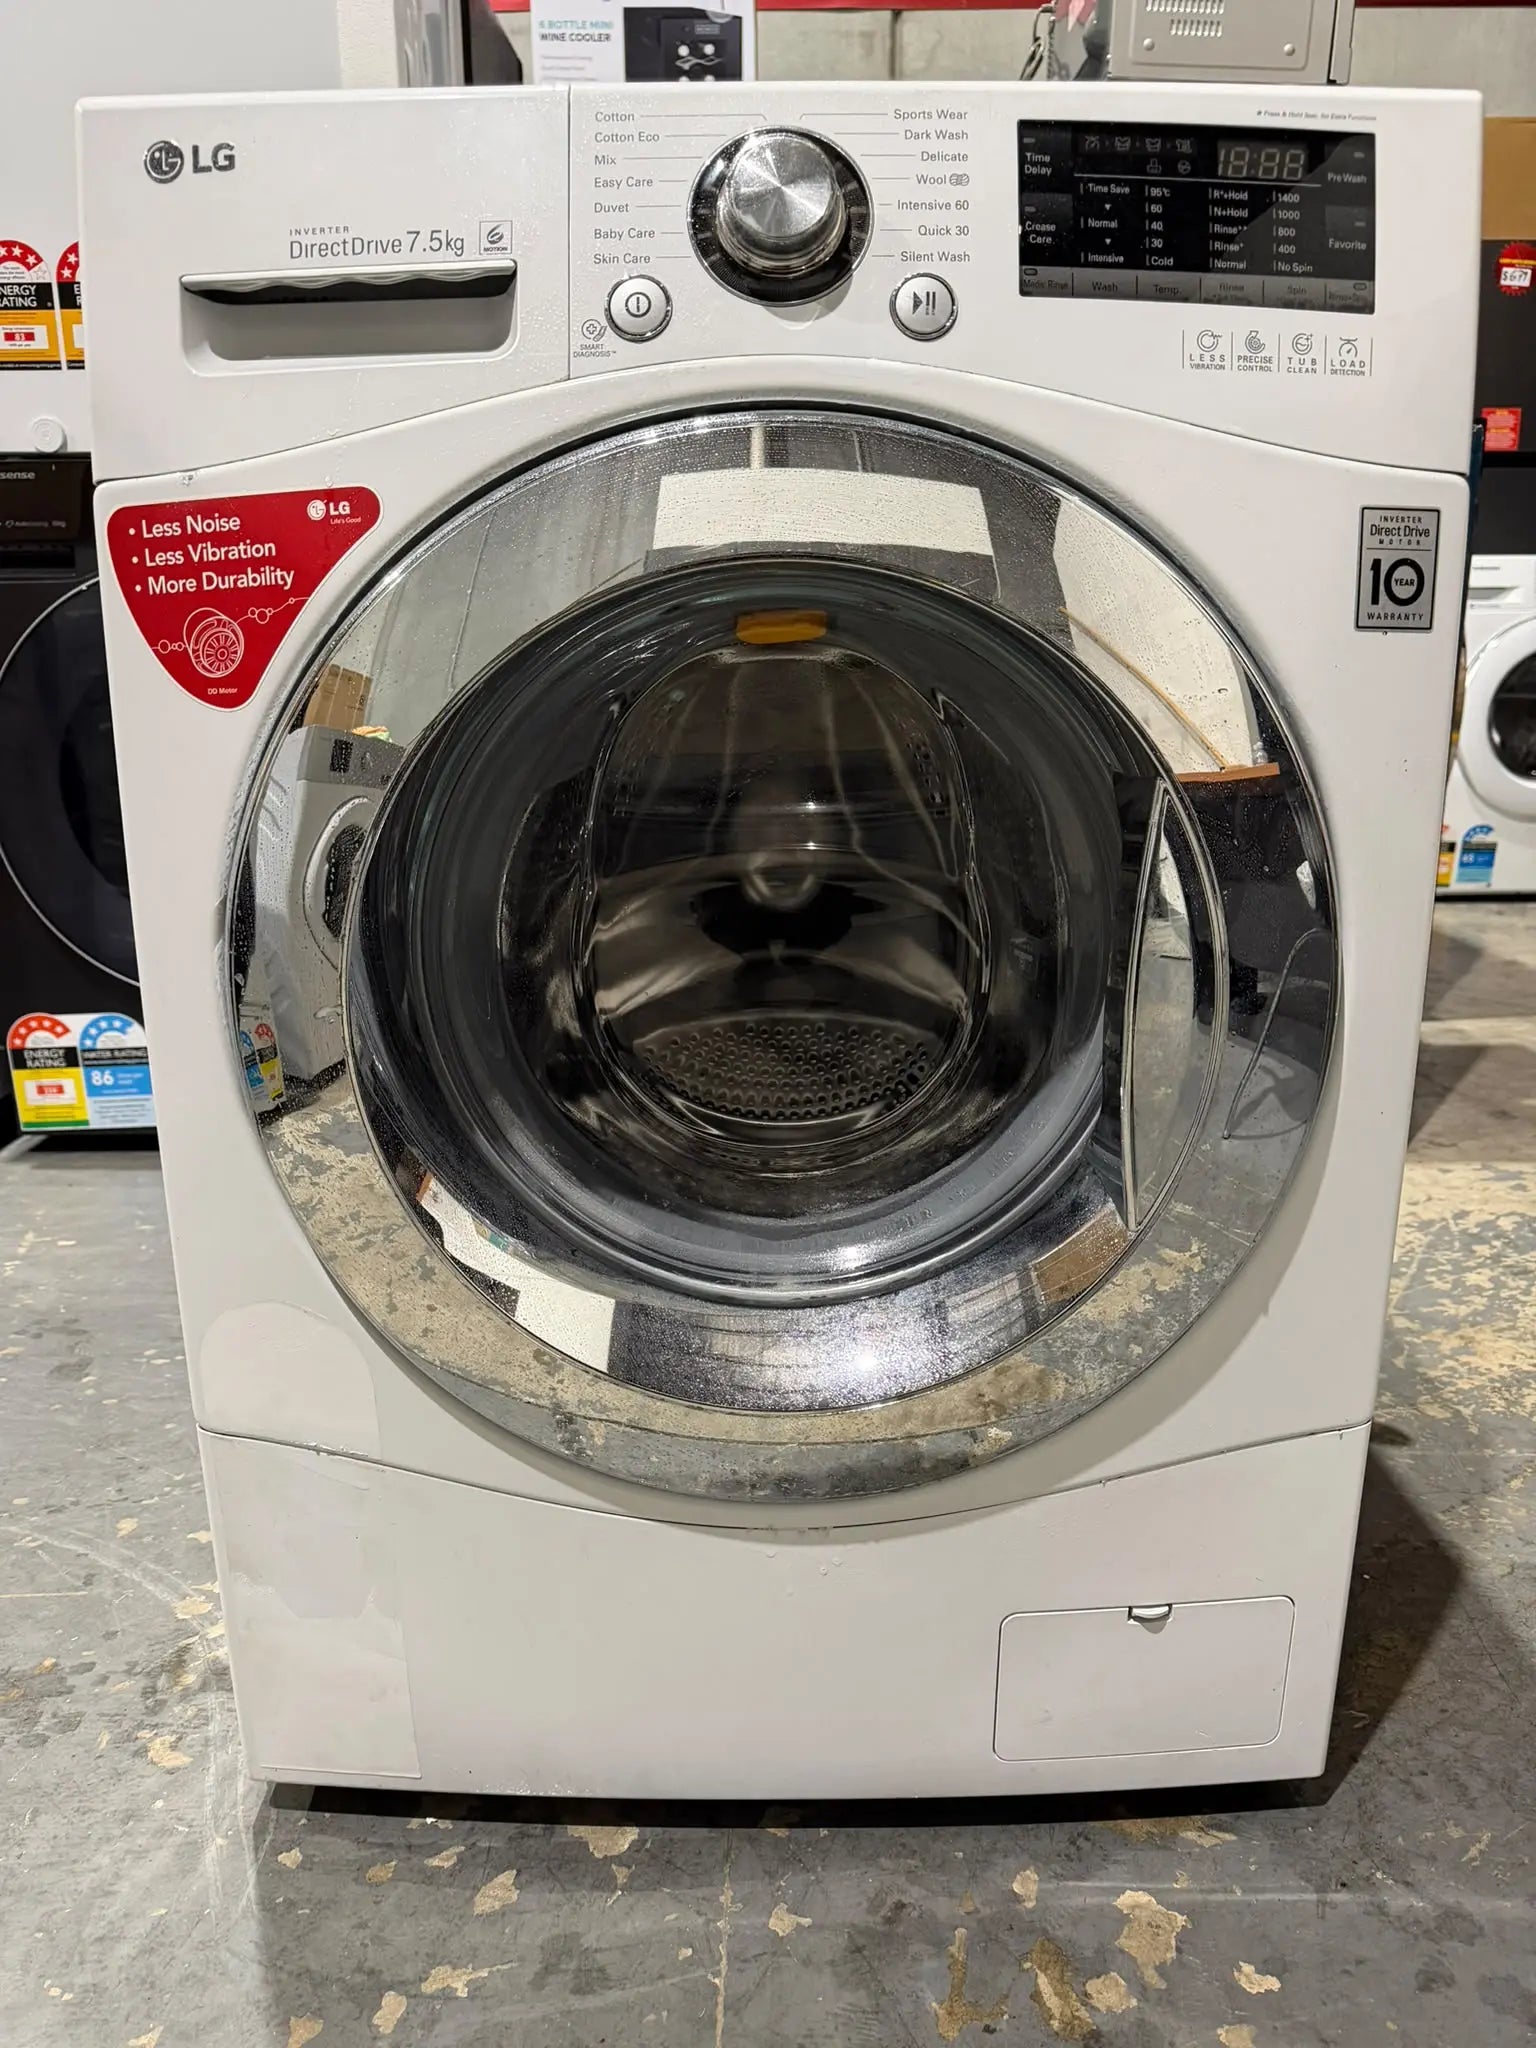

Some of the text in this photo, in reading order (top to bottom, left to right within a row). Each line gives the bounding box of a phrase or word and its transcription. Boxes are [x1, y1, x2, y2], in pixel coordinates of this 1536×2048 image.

[548, 20, 587, 29] BOTTLE
[540, 33, 611, 42] WINE COOLER
[595, 111, 635, 122] Cotton
[894, 108, 968, 121] Sports Wear
[594, 131, 660, 143] Cotton Eco
[904, 129, 968, 140] Dark Wash
[192, 142, 236, 173] LG
[594, 155, 617, 166] Mix
[921, 151, 968, 162] Delicate
[1026, 153, 1051, 163] Time
[1024, 165, 1052, 176] Delay
[594, 176, 654, 189] Easy Care
[916, 174, 947, 185] Wool
[1088, 184, 1130, 194] Time Save
[1278, 193, 1300, 203] 1400
[594, 202, 629, 213] Duvet
[897, 199, 970, 211] Intensive 60
[1150, 204, 1162, 213] 60
[1213, 207, 1248, 218] N+Hold
[1278, 210, 1300, 220] 1000
[1025, 221, 1056, 231] Crease
[1088, 218, 1118, 228] Normal
[1151, 222, 1163, 231] 40
[290, 226, 349, 237] INVERTER
[594, 228, 656, 241] Baby Care
[918, 224, 970, 236] Quick 30
[1278, 227, 1295, 237] 800
[406, 229, 465, 257] 7.5kg
[1029, 234, 1052, 244] Care
[1151, 239, 1163, 248] 30
[1278, 245, 1296, 254] 400
[1328, 239, 1367, 250] Favorite
[593, 253, 651, 265] Skin Care
[900, 250, 971, 262] Silent Wash
[1088, 253, 1124, 263] Intensive
[1151, 257, 1174, 266] Cold
[1214, 259, 1247, 269] Normal
[1278, 262, 1313, 274] No Spin
[0, 285, 37, 296] NERGY
[1092, 281, 1118, 292] Wash
[1153, 285, 1182, 295] Temp.
[1288, 285, 1307, 297] Spin
[1189, 353, 1226, 362] LESS
[1237, 354, 1273, 364] PRECISE
[1287, 357, 1317, 366] TUB
[1189, 362, 1226, 371] VIBRATION
[1237, 364, 1273, 372] CONTROL
[1330, 359, 1366, 369] LOAD
[1286, 366, 1317, 375] CLEAN
[1330, 368, 1366, 377] DETECTION
[0, 471, 36, 480] sense
[329, 501, 351, 516] LG
[1379, 515, 1423, 524] INVERTER
[141, 513, 241, 539] Less Noise
[1370, 524, 1430, 538] Direct Drive
[144, 540, 276, 567] Less Vibration
[148, 565, 295, 595] More Durability
[1370, 557, 1425, 607] 10
[1394, 578, 1415, 587] YEAR
[1367, 612, 1424, 621] WARRANTY
[219, 687, 238, 695] Motor
[90, 1069, 114, 1086] 86
